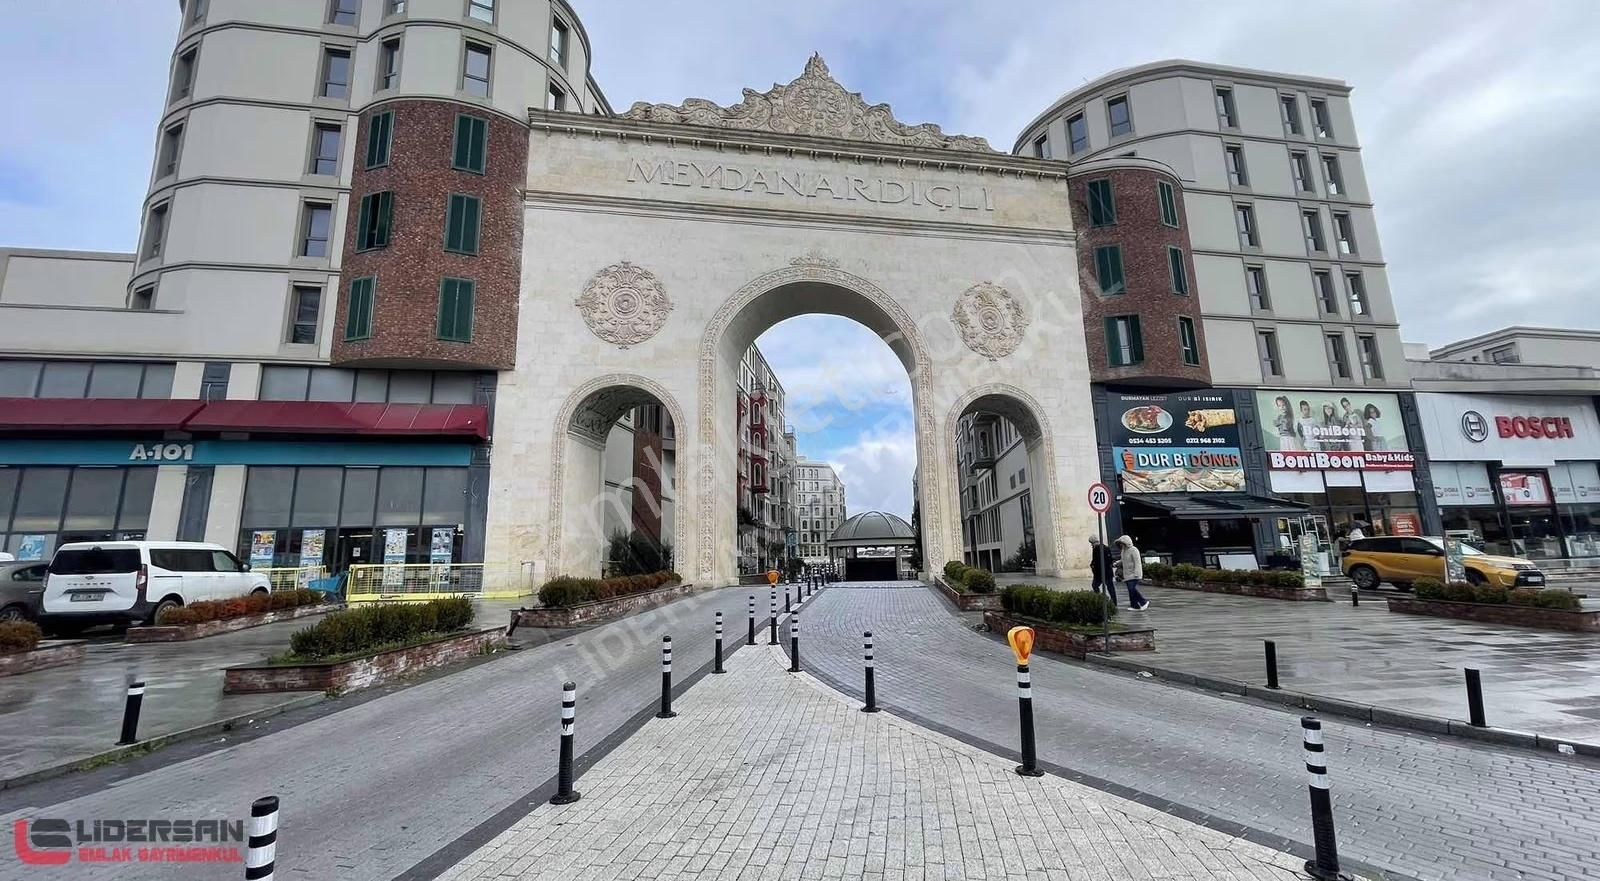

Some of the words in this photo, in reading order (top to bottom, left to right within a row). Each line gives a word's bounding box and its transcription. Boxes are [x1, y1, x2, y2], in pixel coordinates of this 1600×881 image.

[1302, 425, 1366, 437] BoniBoon
[1494, 416, 1574, 439] BOSCH
[1138, 453, 1170, 467] DUR
[1190, 450, 1240, 467] DÖNER
[1270, 452, 1366, 468] BoniBoon
[1365, 453, 1415, 463] Baby&Kids
[1093, 491, 1106, 505] 20
